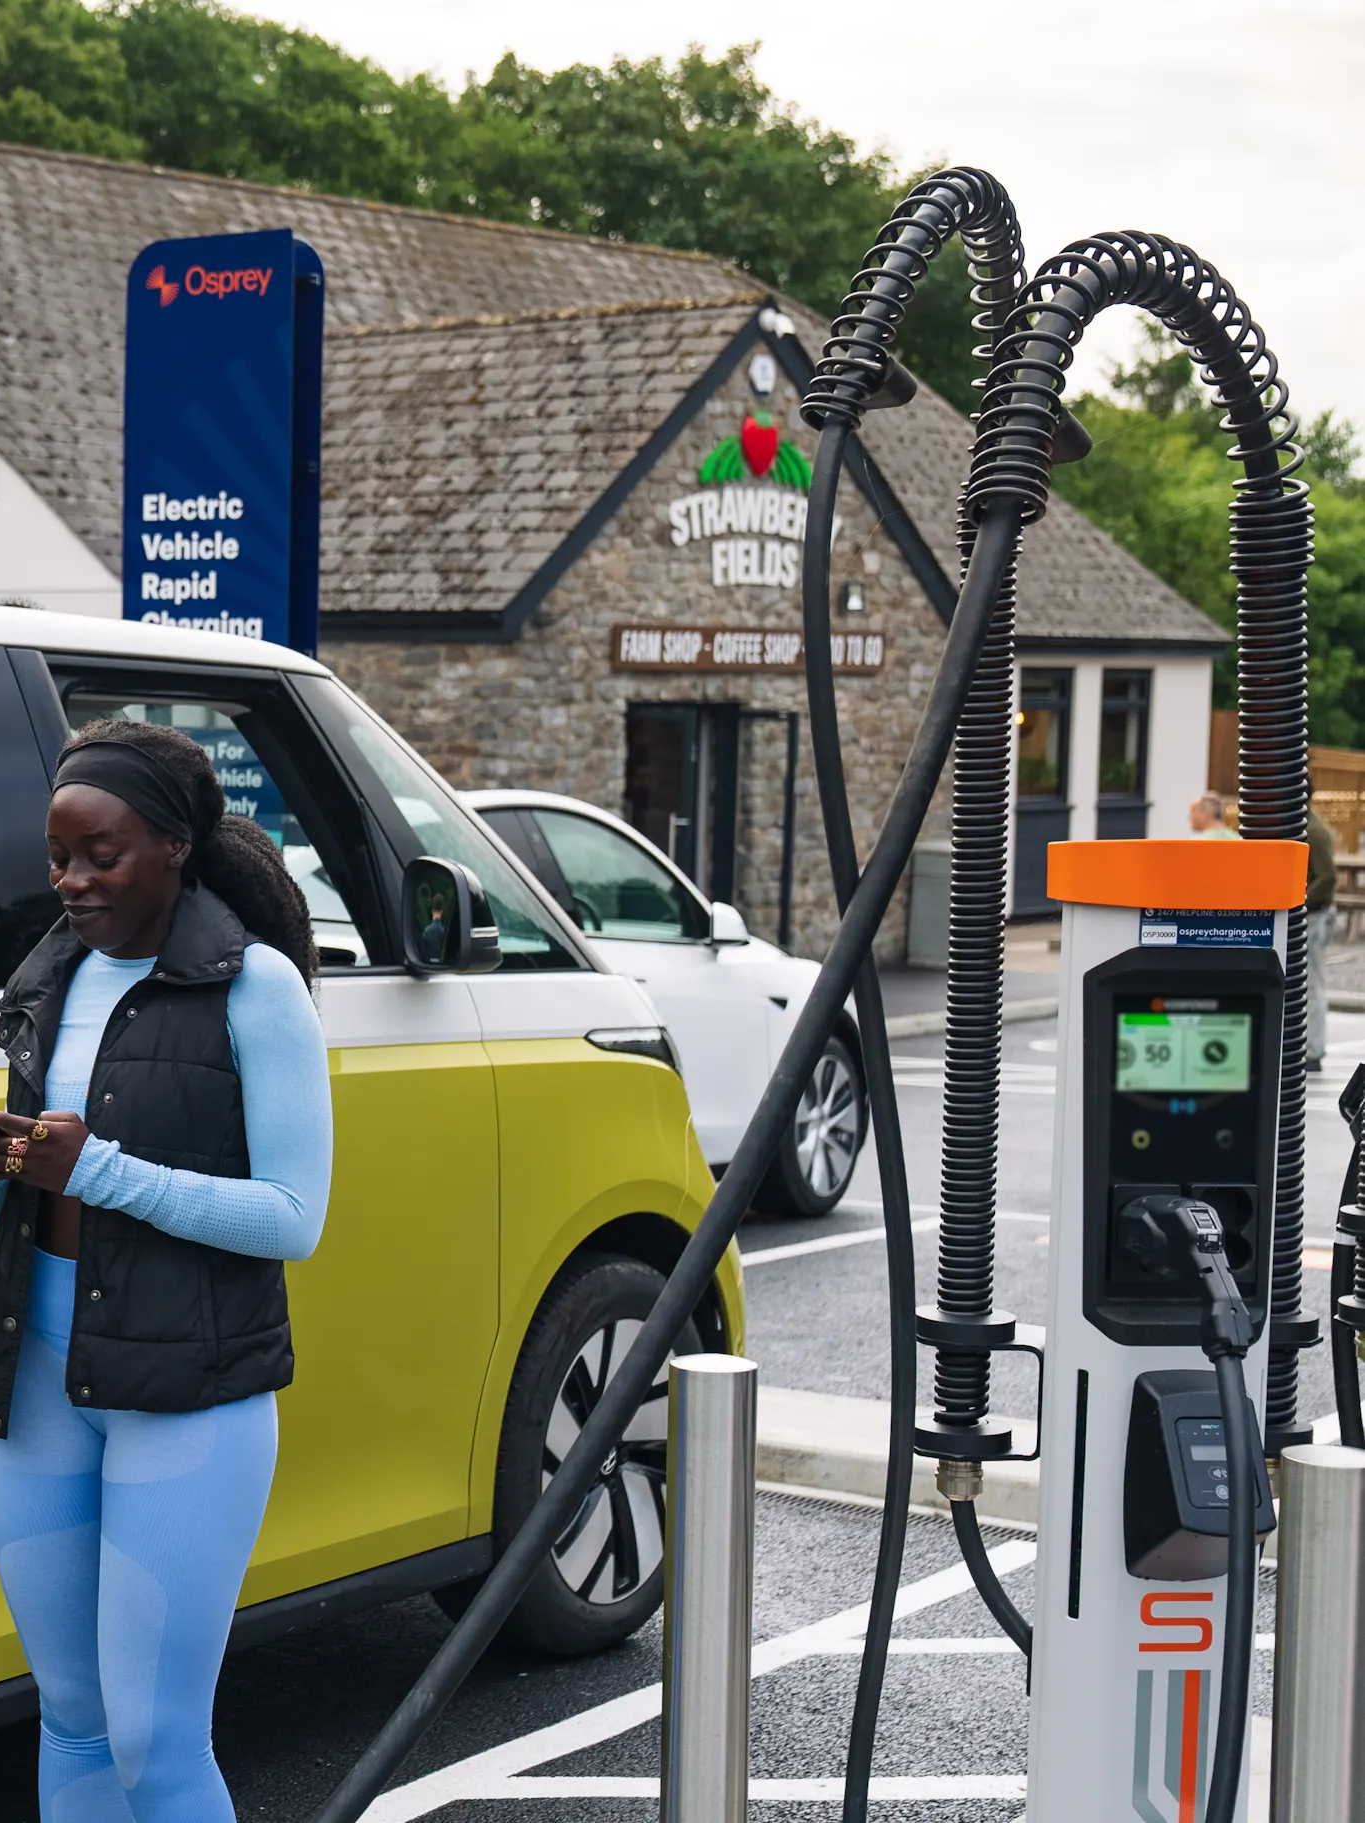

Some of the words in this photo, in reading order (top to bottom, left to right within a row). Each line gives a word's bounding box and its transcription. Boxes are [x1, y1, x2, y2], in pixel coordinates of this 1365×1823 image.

[184, 265, 273, 300] Osprey
[142, 490, 244, 522] Electric
[669, 487, 844, 554] STRAWBERY
[141, 530, 240, 560] Vehicle
[711, 539, 800, 589] FIELDS
[141, 570, 217, 605] Rapid
[620, 630, 662, 662] FARM
[663, 630, 702, 663] SHOP
[713, 631, 763, 664] COFFEE
[764, 632, 801, 665] SHOP
[846, 634, 864, 666] TO
[864, 634, 884, 666] GO
[217, 741, 246, 760] For
[216, 767, 263, 788] hicle
[1142, 931, 1176, 939] OSP30000
[1179, 927, 1272, 938] ospreycharging.co.uk
[1144, 1043, 1172, 1064] 50
